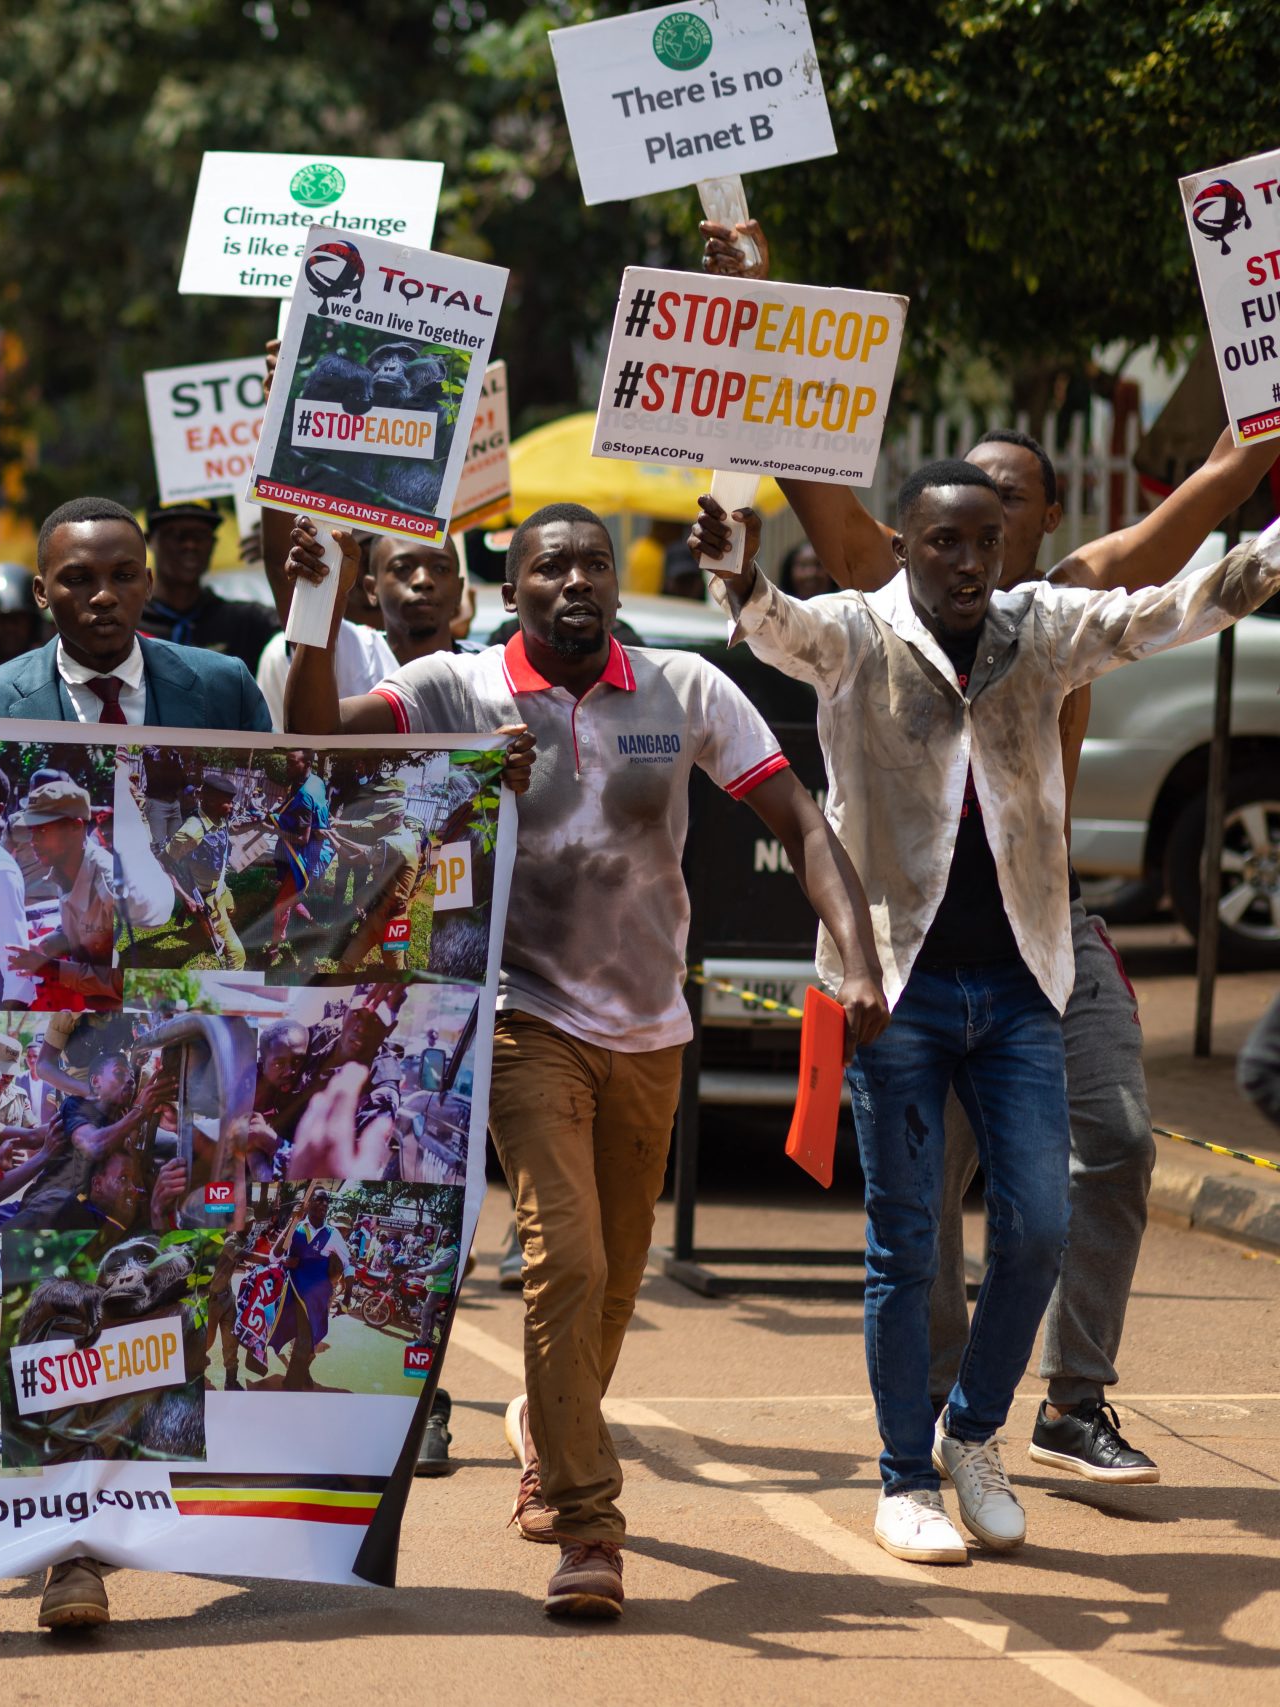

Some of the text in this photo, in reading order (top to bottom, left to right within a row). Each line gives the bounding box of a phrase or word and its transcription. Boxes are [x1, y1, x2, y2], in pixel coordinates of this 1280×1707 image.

[612, 67, 783, 118] There is no
[645, 114, 774, 164] Planet B
[223, 206, 407, 237] Climate change
[223, 236, 241, 255] is
[247, 237, 289, 257] like
[239, 267, 293, 288] time
[378, 266, 493, 316] TOTAL
[331, 302, 485, 350] we can live Together
[624, 288, 890, 363] #STOPEACOP
[1223, 335, 1278, 372] OUR
[171, 373, 267, 418] STO
[613, 360, 877, 434] #STOPEACOP
[297, 409, 432, 448] #STOPEACOP
[1242, 415, 1280, 435] STUDE
[601, 441, 863, 479] @StopEACOPug www.stopeacopug.com
[258, 484, 326, 509] STUDENTS
[329, 501, 388, 524] AGAINST
[390, 515, 434, 534] EACOP
[617, 734, 680, 755] NANGABO
[630, 756, 673, 765] FOUNDATION
[388, 924, 408, 939] NP
[209, 1186, 230, 1200] NP
[20, 1332, 177, 1399] #STOPEACOP
[409, 1351, 430, 1366] NP
